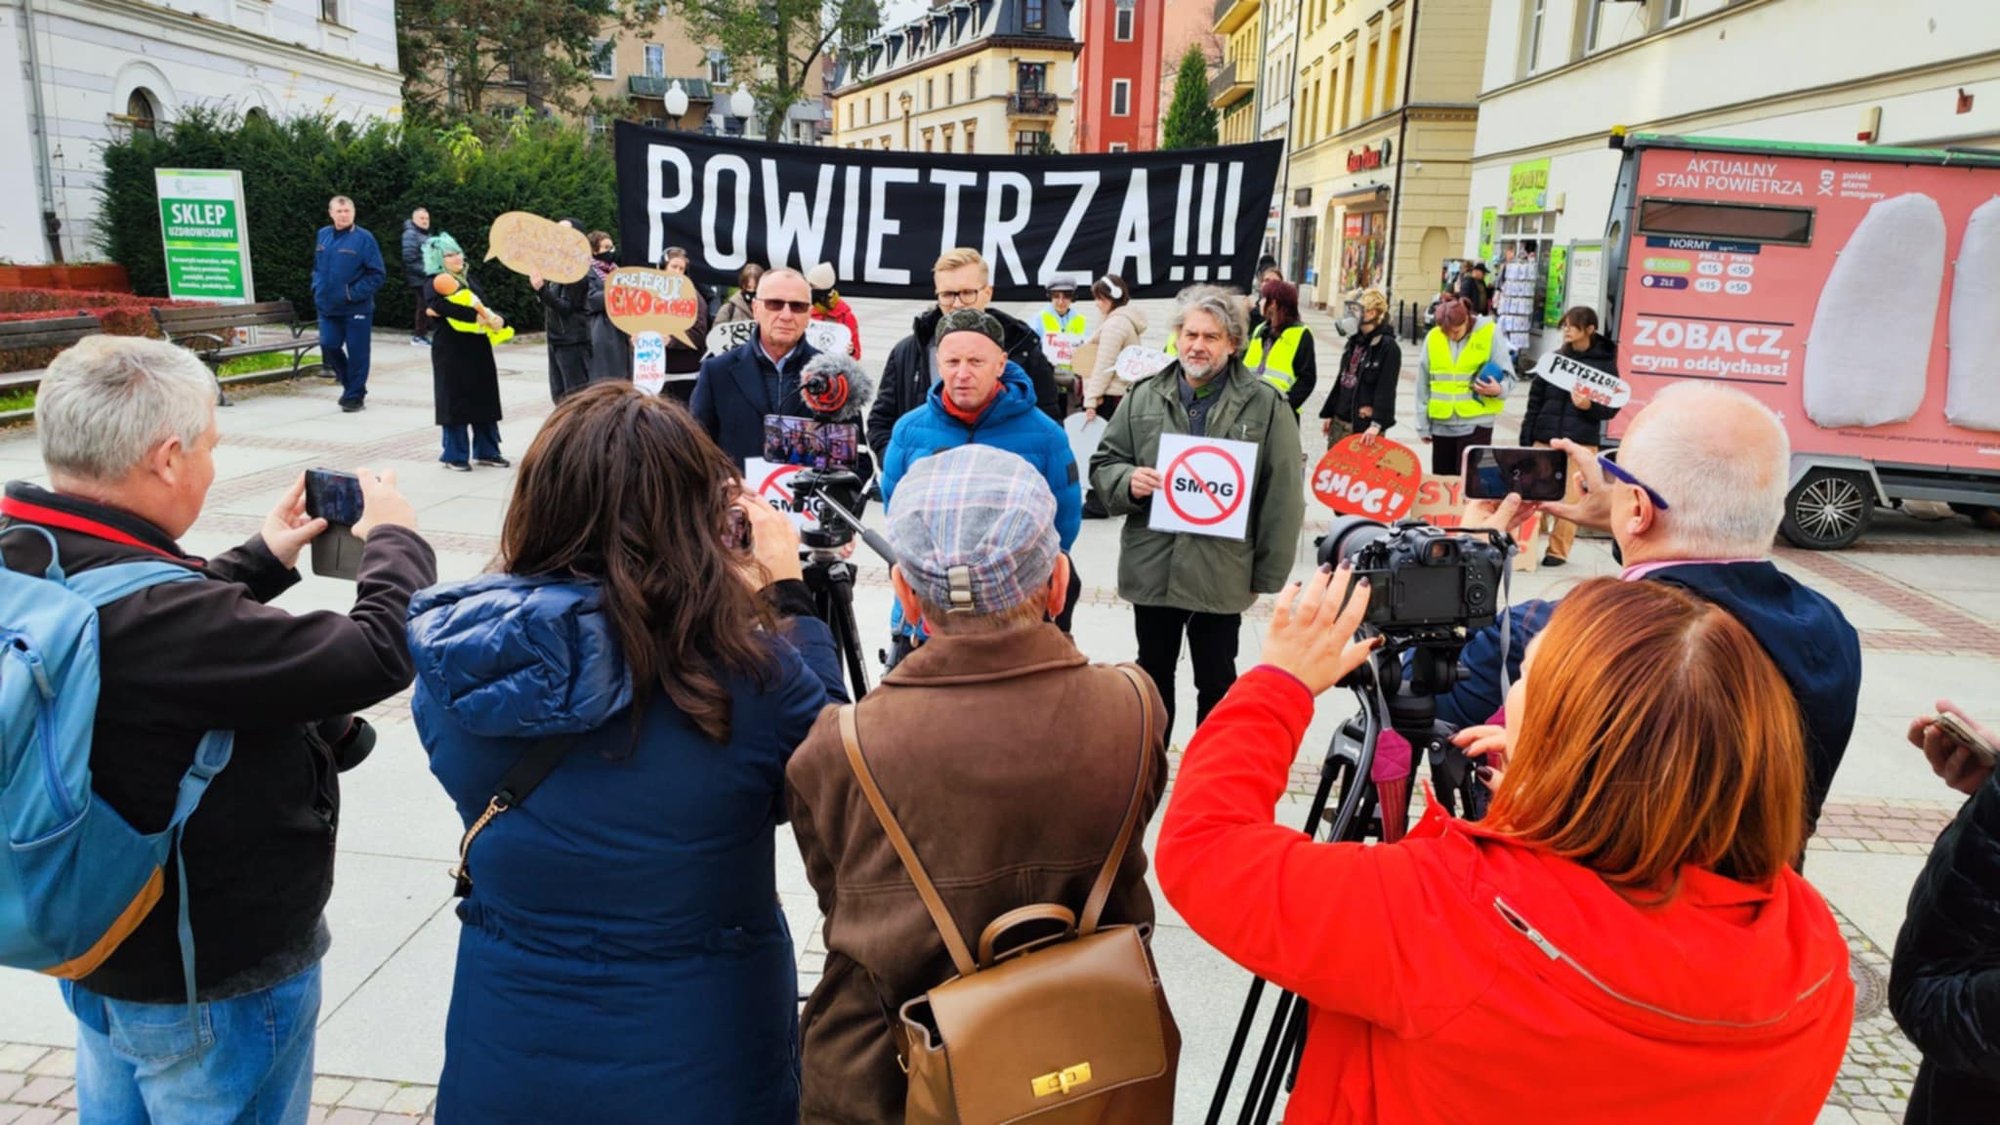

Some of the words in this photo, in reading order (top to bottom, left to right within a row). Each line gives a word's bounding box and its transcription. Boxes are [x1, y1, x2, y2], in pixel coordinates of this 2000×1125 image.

[1687, 159, 1778, 177] AKTUALNY
[1656, 173, 1700, 189] STAN
[1705, 175, 1804, 196] POWIETRZA
[170, 202, 227, 225] SKLEP
[647, 143, 1244, 286] POWIETRZA!!!
[1668, 238, 1712, 251] NORMY
[1633, 319, 1791, 359] ZOBACZ,
[1631, 353, 1679, 372] czym
[1684, 355, 1788, 378] oddychasz!
[1174, 477, 1234, 497] SMOG
[1314, 469, 1404, 517] SMOG!
